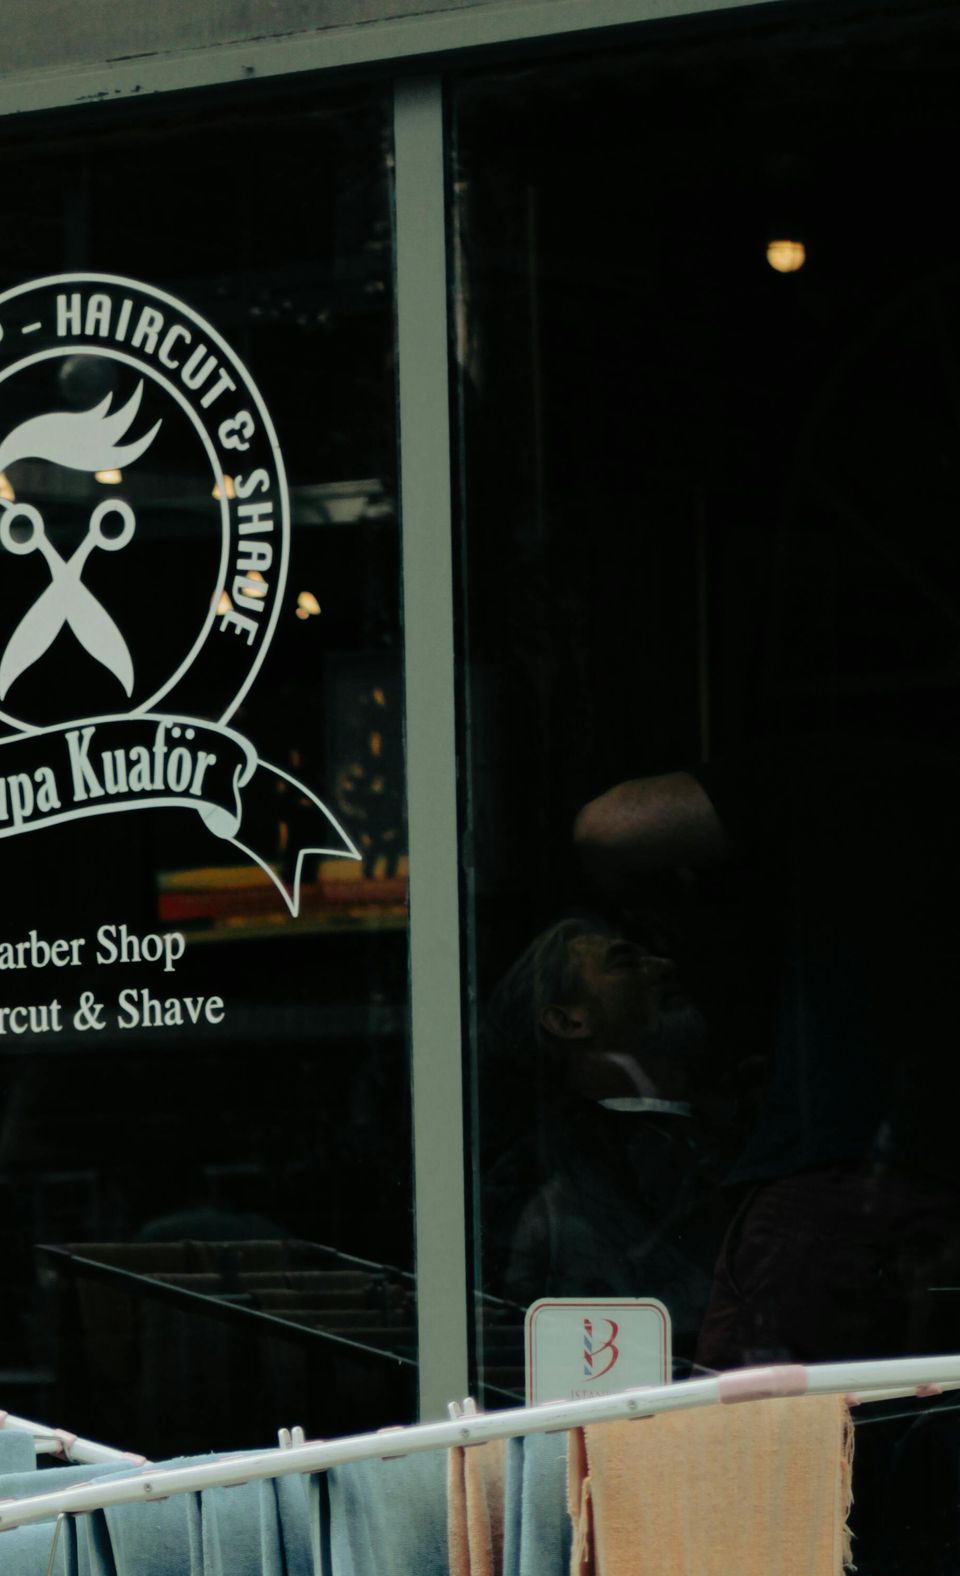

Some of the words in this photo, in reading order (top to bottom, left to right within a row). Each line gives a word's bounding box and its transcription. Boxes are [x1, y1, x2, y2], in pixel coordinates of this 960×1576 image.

[56, 293, 237, 409] HAIRCUT
[217, 409, 256, 452] &
[219, 467, 275, 647] SHAVE
[64, 720, 218, 802] Kuaför
[95, 923, 187, 972] Shop
[72, 991, 107, 1032] &
[116, 987, 226, 1030] Shave
